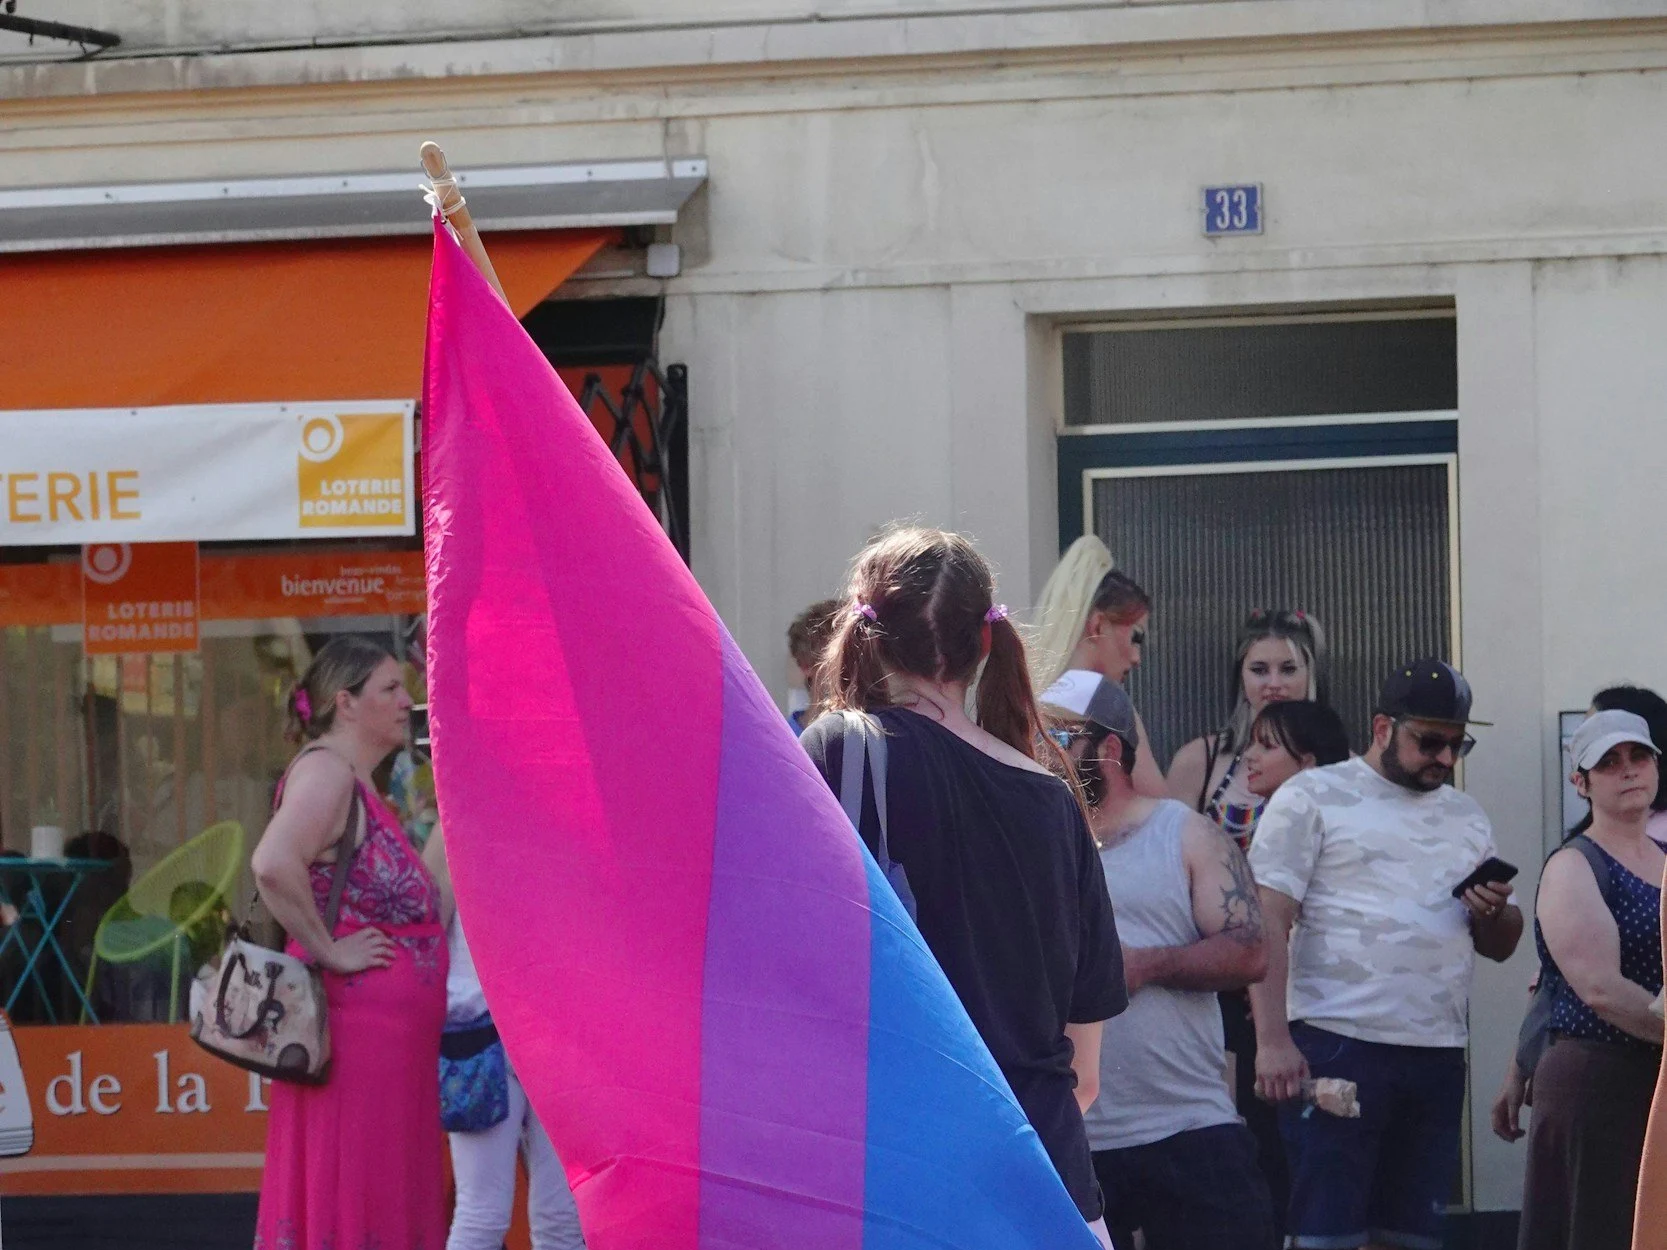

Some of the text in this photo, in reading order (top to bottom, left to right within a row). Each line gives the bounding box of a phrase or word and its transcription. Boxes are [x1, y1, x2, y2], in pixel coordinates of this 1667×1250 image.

[1216, 190, 1247, 229] 33
[0, 470, 141, 522] ERIE
[321, 479, 402, 495] LOTERIE
[302, 499, 402, 514] ROMANDE
[281, 575, 384, 596] bienvenue
[107, 601, 194, 619] LOTERIE
[88, 622, 194, 641] ROMANDE
[45, 1050, 122, 1115] de
[154, 1049, 211, 1113] la
